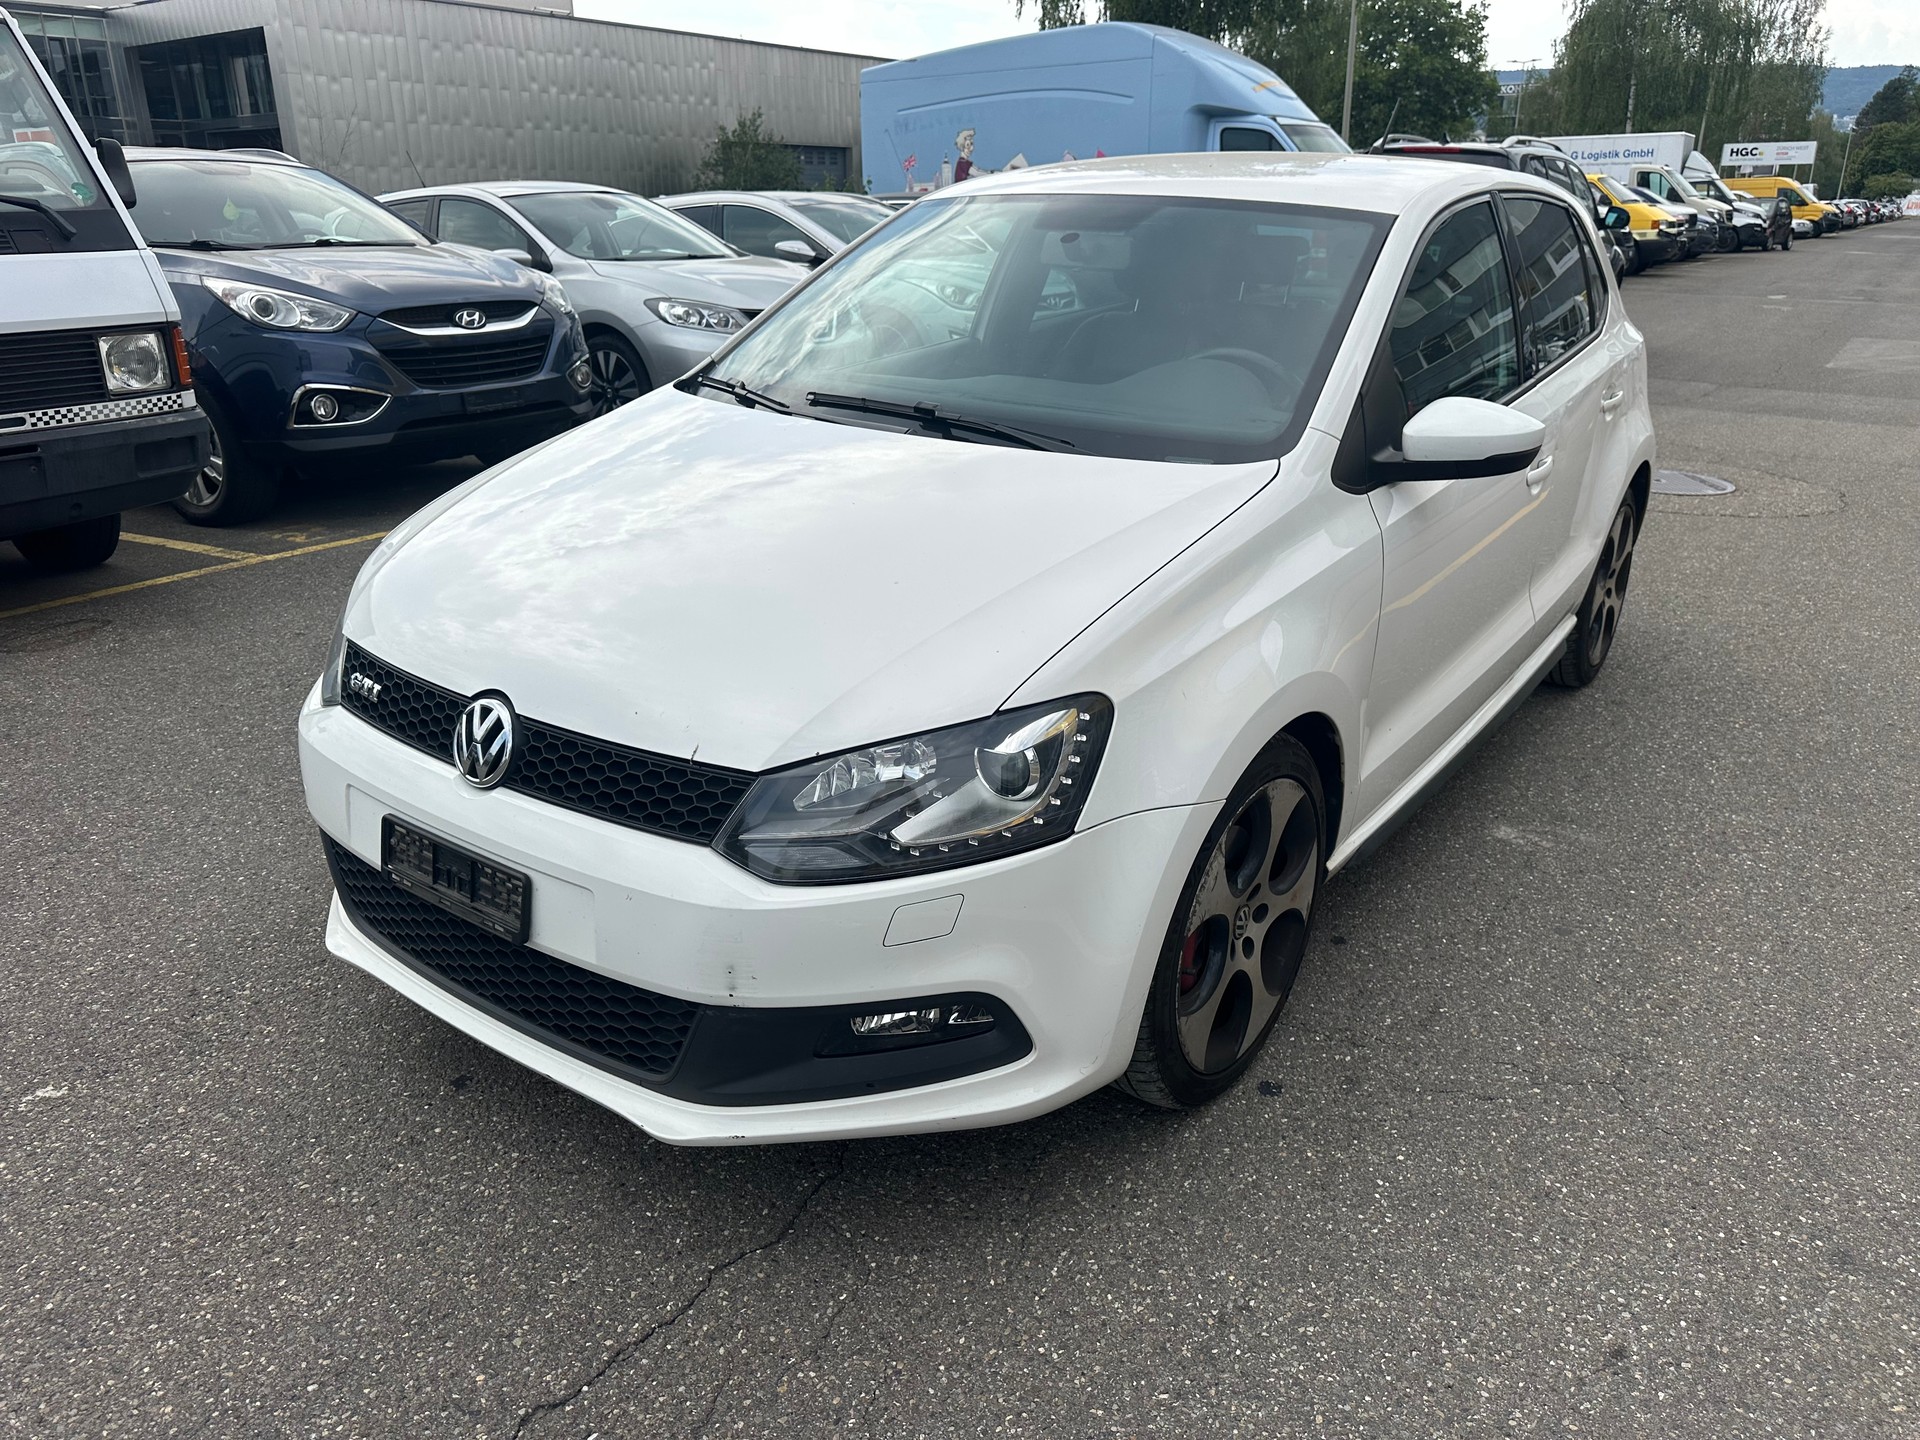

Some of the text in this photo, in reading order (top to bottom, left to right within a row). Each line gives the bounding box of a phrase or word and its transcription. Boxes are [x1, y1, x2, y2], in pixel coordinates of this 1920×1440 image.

[1581, 150, 1620, 161] Logistik
[1623, 148, 1654, 158] GmbH
[1729, 147, 1759, 157] HGC
[348, 672, 382, 704] GTI
